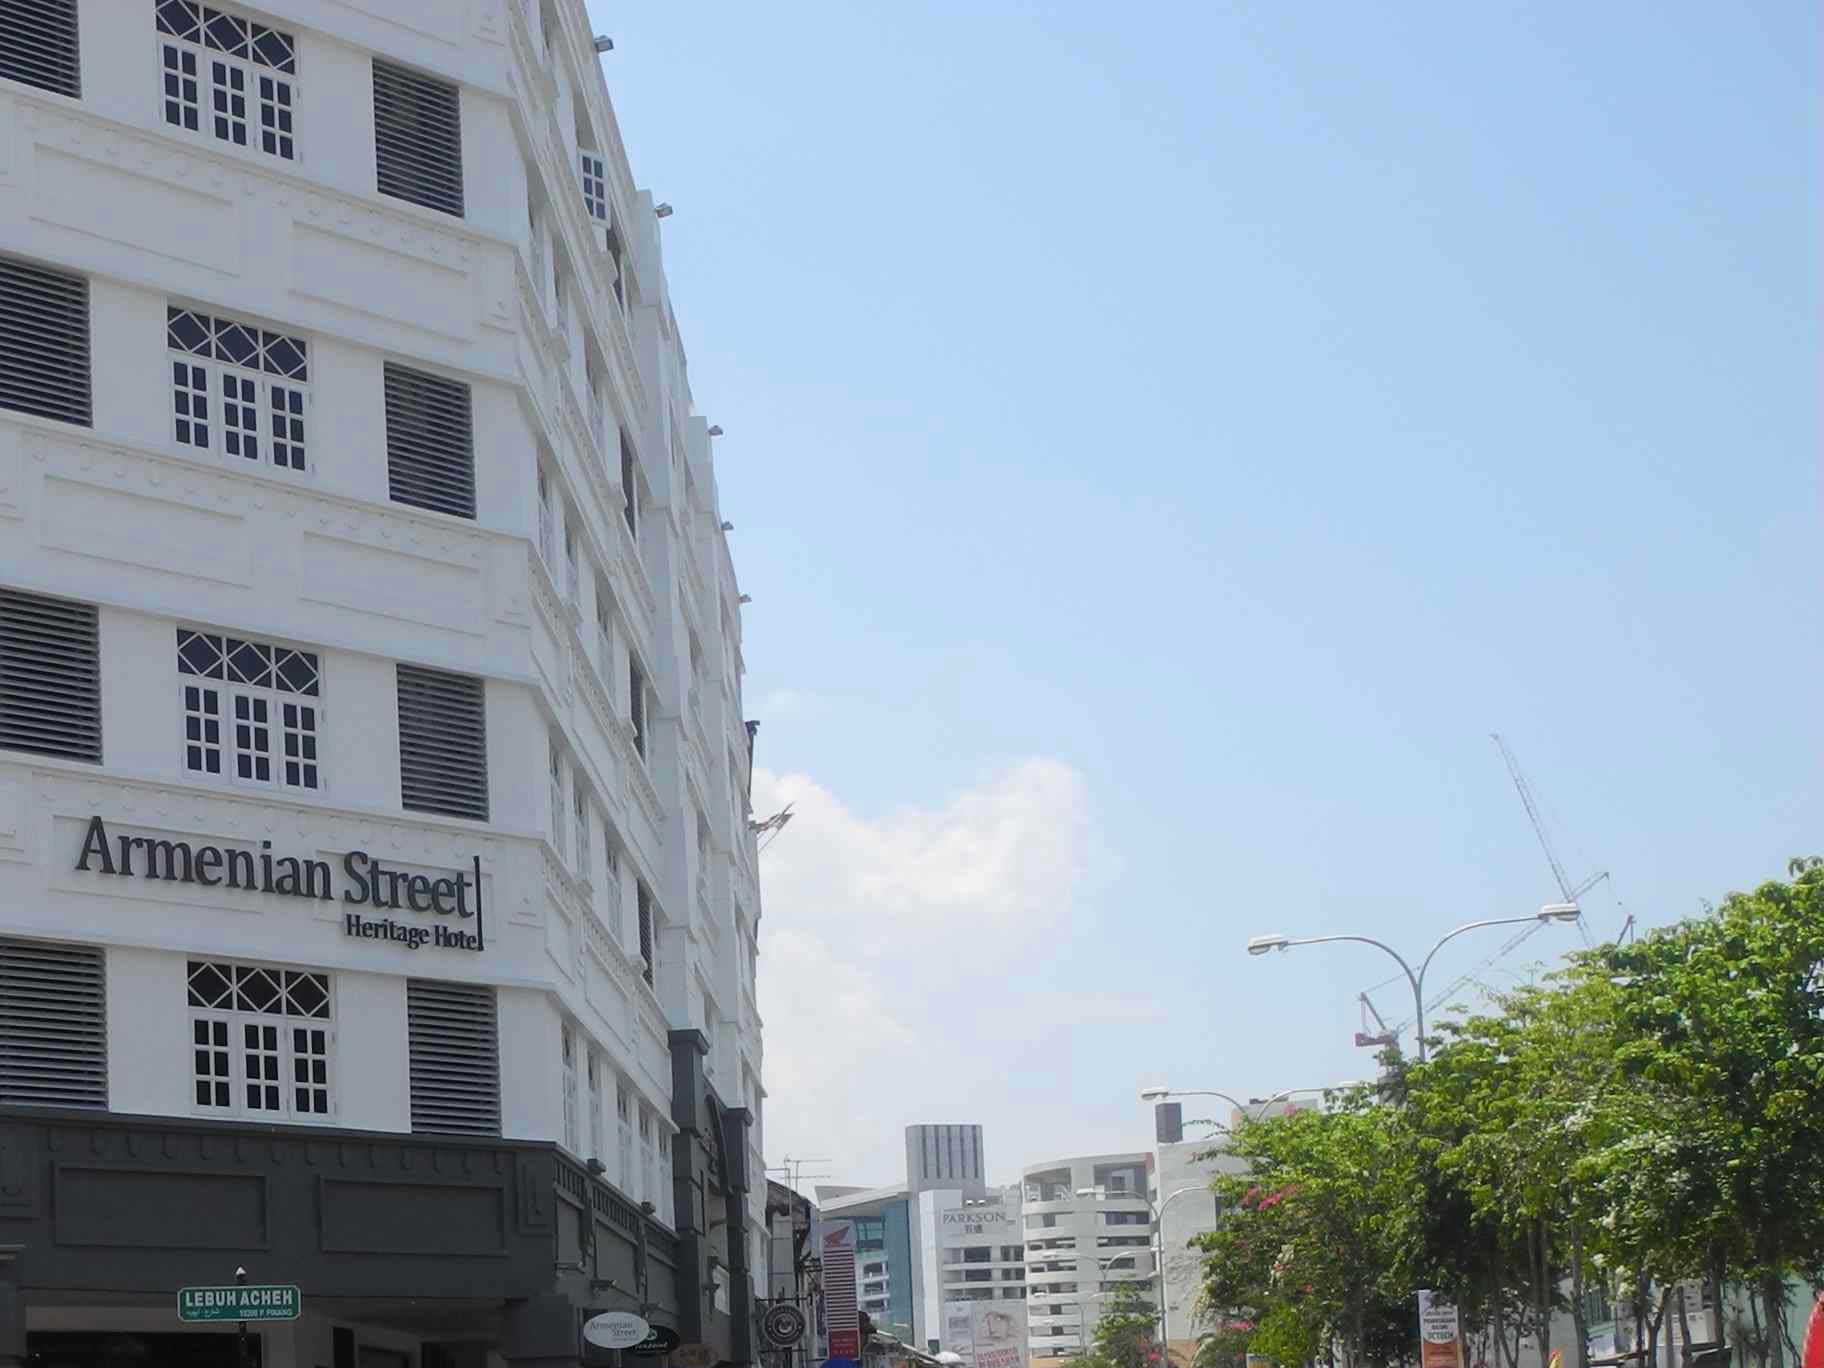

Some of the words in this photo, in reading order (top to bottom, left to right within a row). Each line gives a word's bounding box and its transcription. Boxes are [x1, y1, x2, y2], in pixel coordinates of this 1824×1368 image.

[75, 815, 335, 900] Armenian
[344, 851, 474, 919] Street
[345, 913, 431, 950] Heritage
[943, 1212, 1006, 1225] PARKSON
[185, 1290, 237, 1307] LEBUH
[239, 1290, 293, 1306] ACHEH
